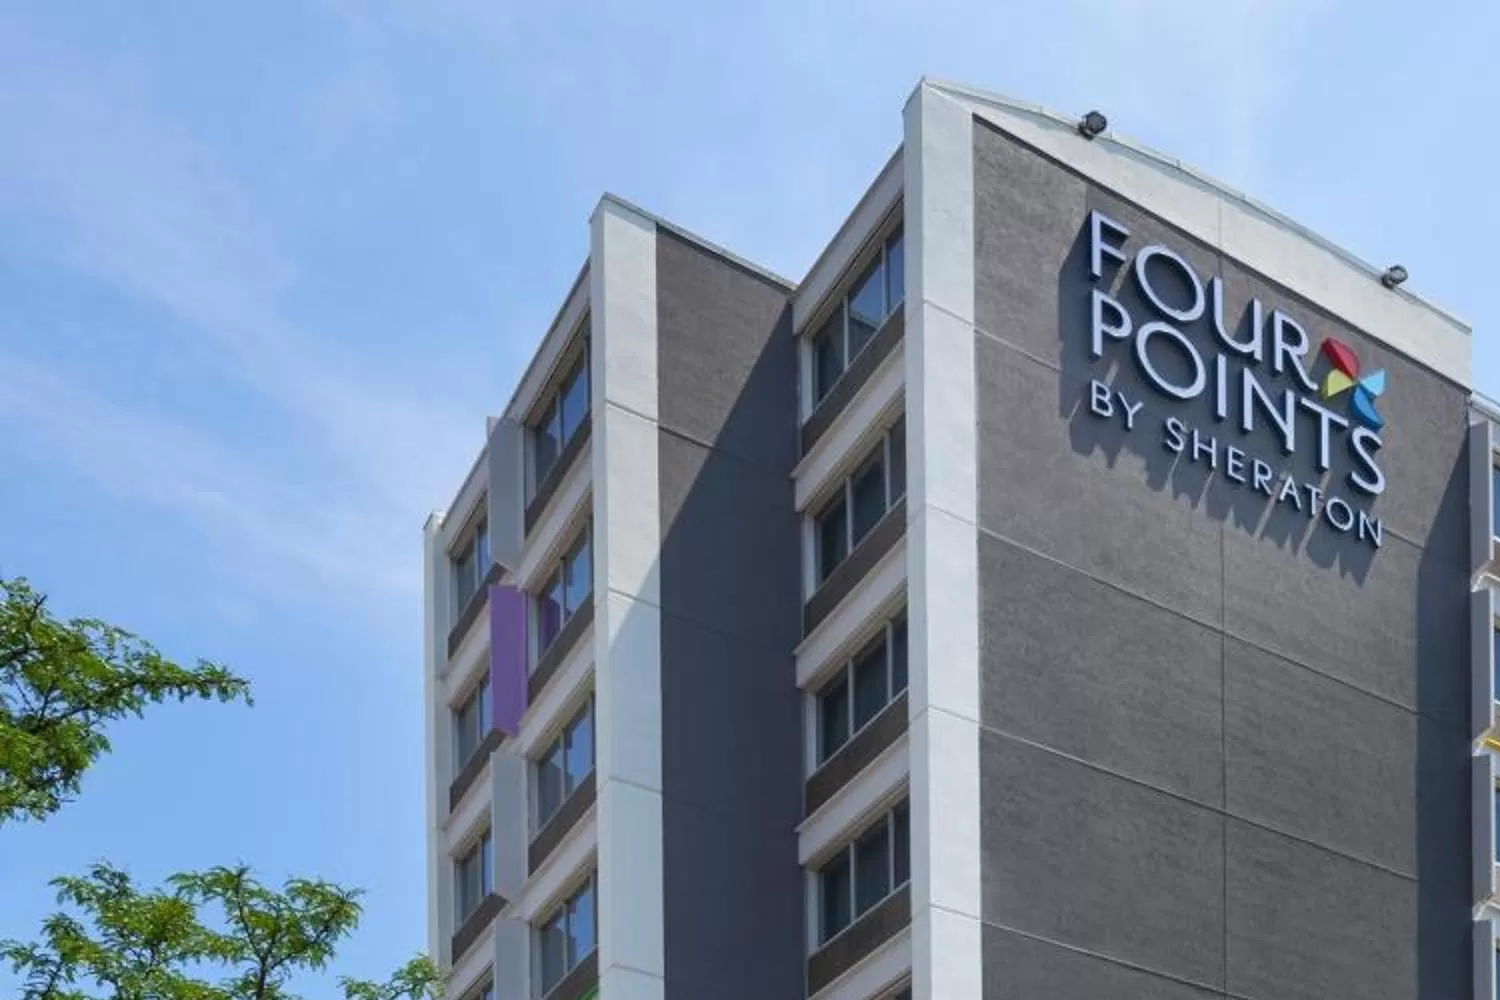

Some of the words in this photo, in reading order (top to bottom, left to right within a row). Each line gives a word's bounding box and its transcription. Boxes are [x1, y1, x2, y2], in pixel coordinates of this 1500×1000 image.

[1090, 209, 1319, 391] FOUR
[1090, 379, 1143, 430] BY
[1164, 416, 1382, 548] SHERATON
[1091, 288, 1386, 495] POINTS
